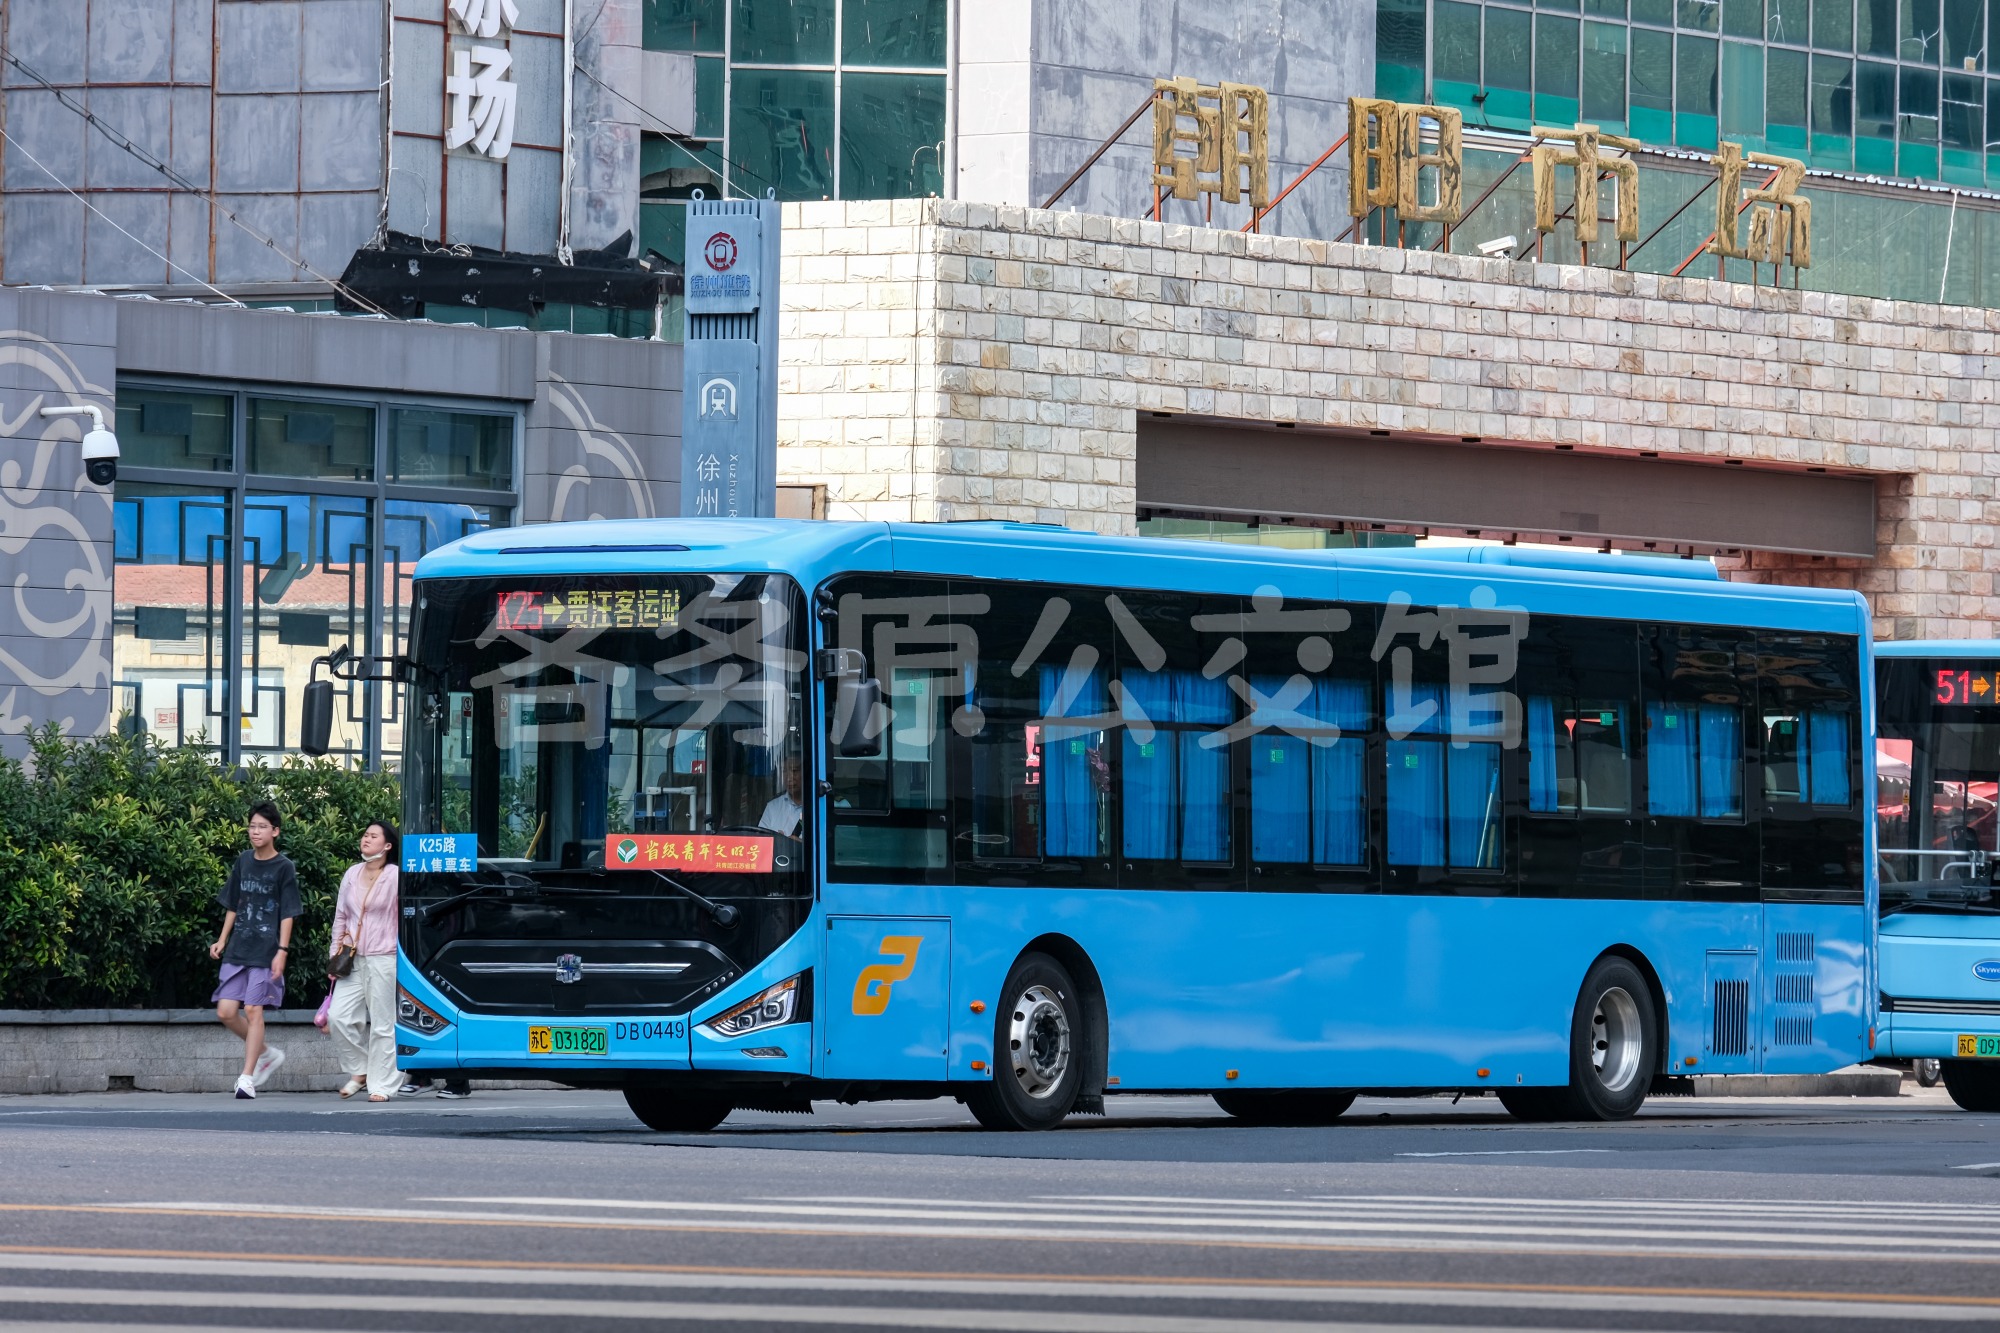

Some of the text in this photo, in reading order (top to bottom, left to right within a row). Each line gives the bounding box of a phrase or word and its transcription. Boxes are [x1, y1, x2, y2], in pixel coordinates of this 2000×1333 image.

[1150, 76, 1811, 269] 朝阳市场
[690, 274, 751, 290] 徐州地铁
[690, 289, 750, 298] XUZHOU METRO
[696, 453, 720, 515] 徐州
[729, 454, 739, 505] Xuzhou
[496, 589, 680, 629] K25 贾汪客运站
[1937, 669, 1969, 704] 51
[419, 836, 456, 854] K25路
[644, 839, 761, 862] 省级青年文明号
[406, 857, 472, 872] 无人售票车
[616, 1021, 685, 1041] DB0449
